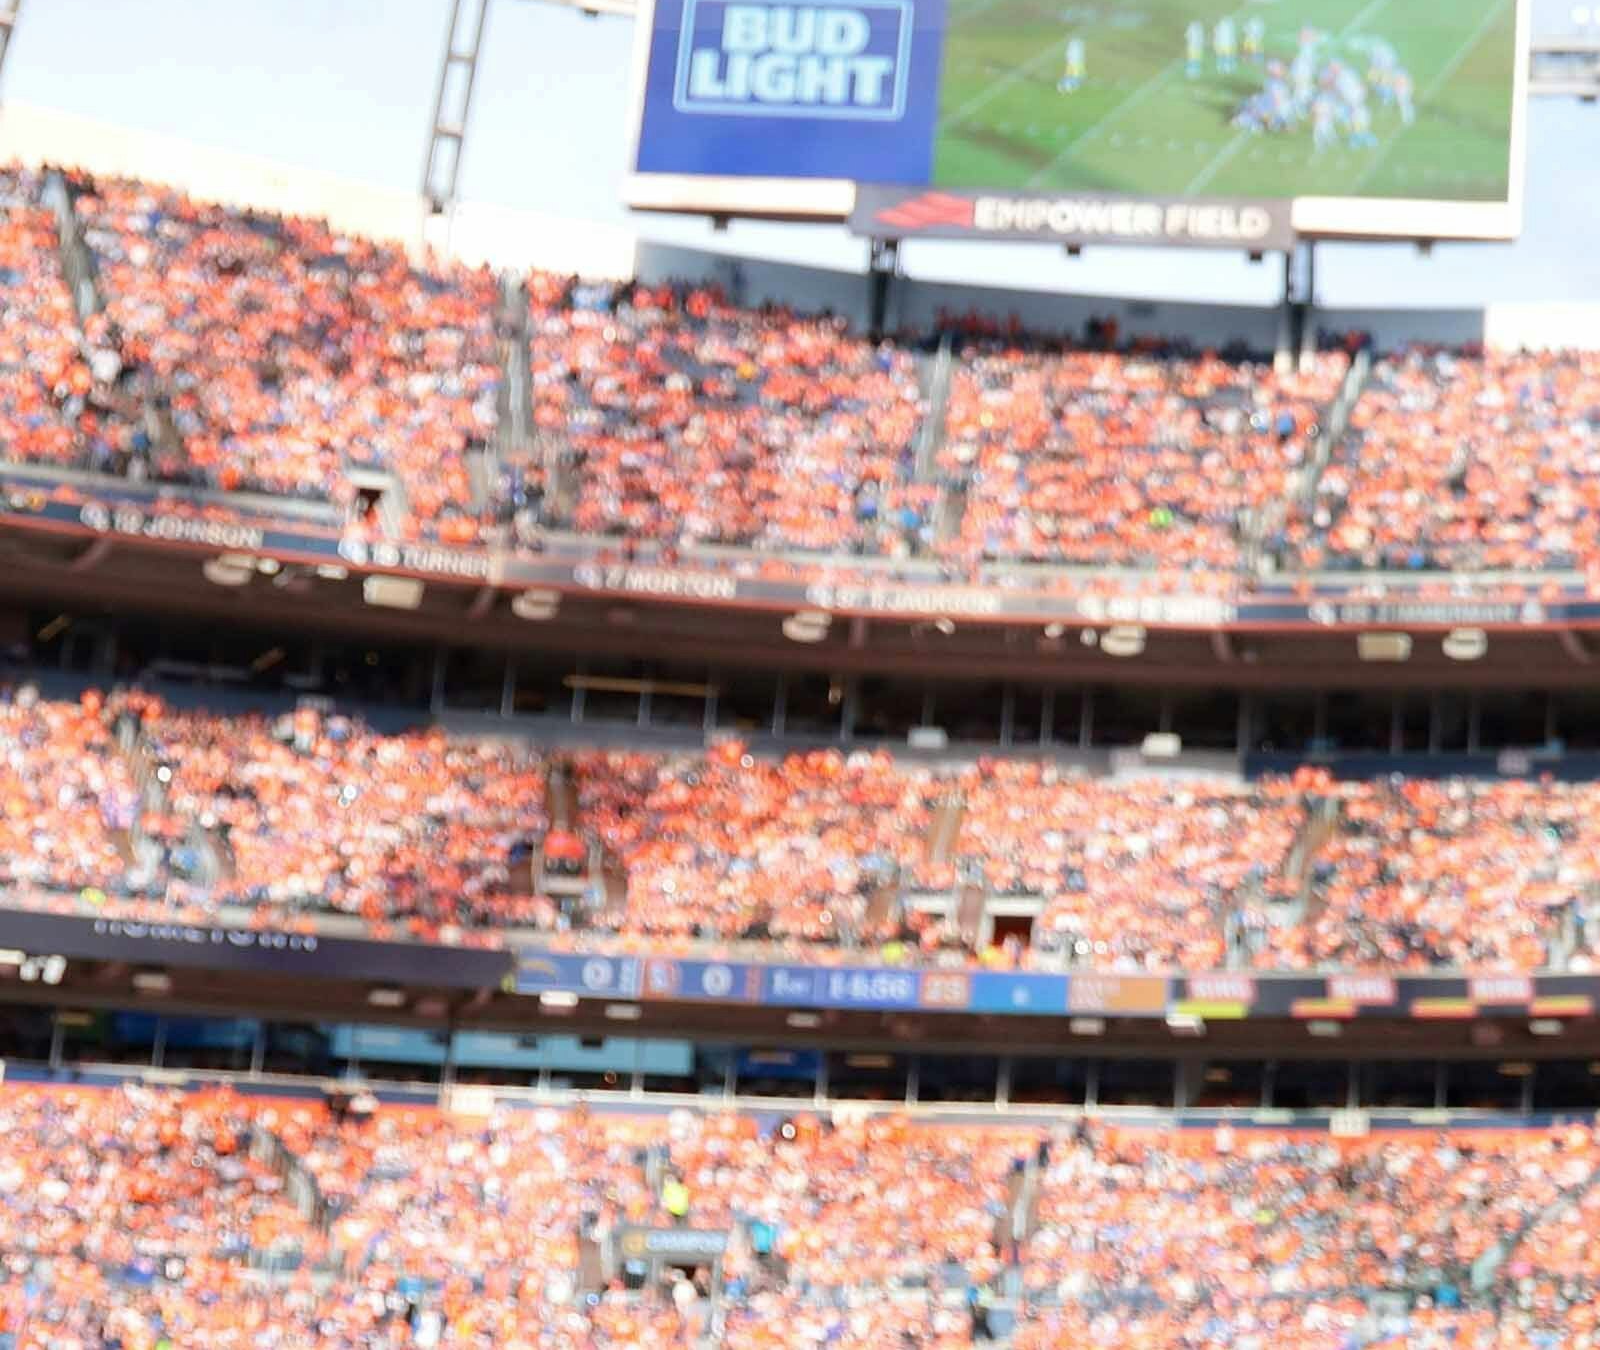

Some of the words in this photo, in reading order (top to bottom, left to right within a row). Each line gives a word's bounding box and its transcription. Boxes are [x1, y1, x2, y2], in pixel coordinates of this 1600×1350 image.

[721, 4, 871, 55] BUD
[688, 47, 894, 106] LIGHT
[973, 195, 1163, 236] EMPOWER
[1164, 203, 1272, 240] FIELD
[143, 515, 266, 550] JOHNSON
